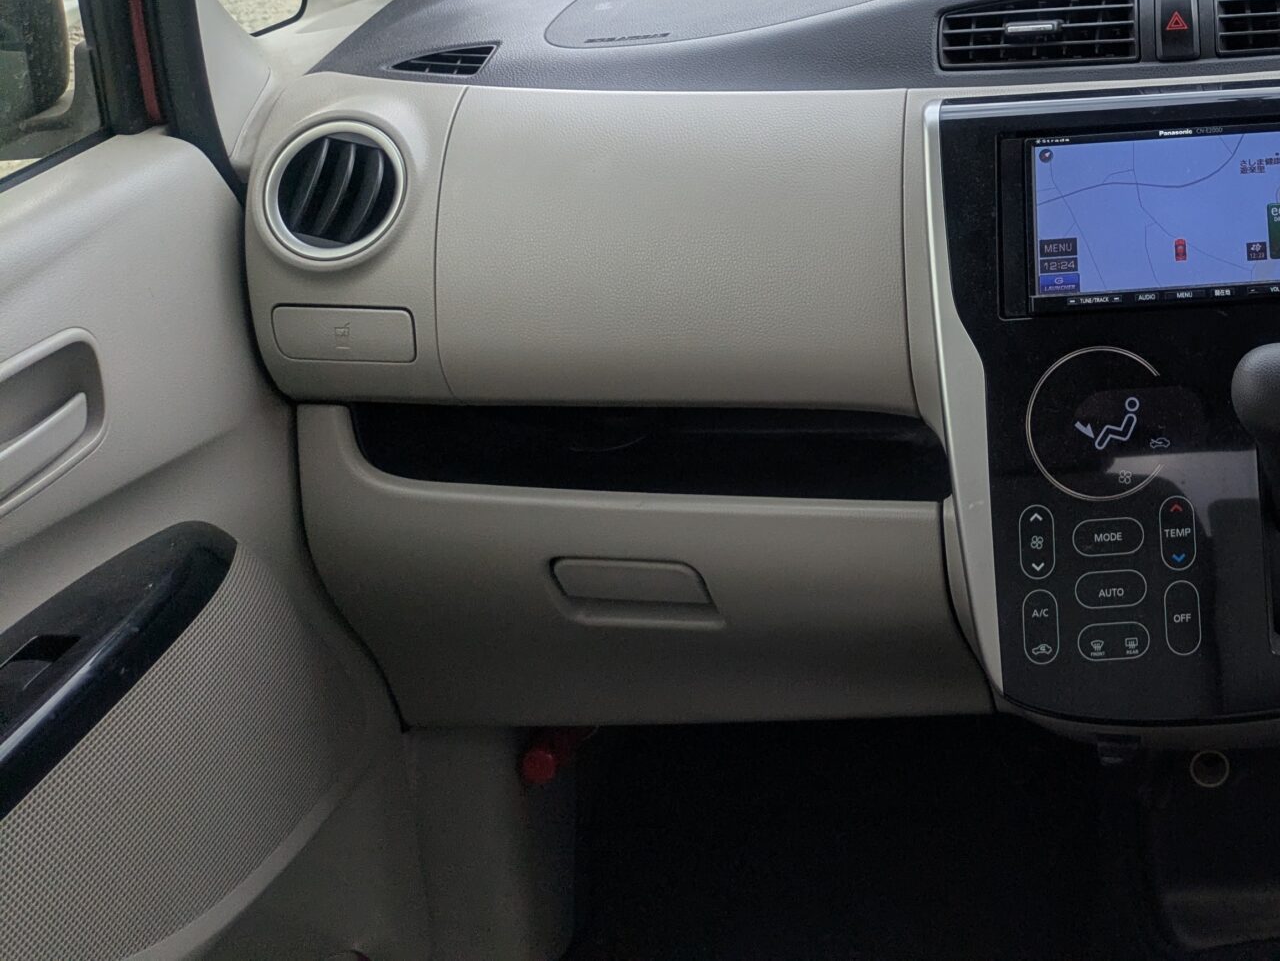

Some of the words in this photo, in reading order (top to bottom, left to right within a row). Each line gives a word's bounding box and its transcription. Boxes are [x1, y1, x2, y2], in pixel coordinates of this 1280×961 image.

[1158, 129, 1193, 137] Panasonic
[1044, 243, 1073, 254] MENU
[1044, 260, 1075, 271] 12:24
[1080, 296, 1110, 304] TUNE/TRACK
[1138, 293, 1156, 301] AUDIO
[1176, 291, 1193, 299] MENU
[1094, 532, 1123, 543] MODE
[1164, 527, 1191, 538] TEMP
[1098, 587, 1125, 598] AUTO
[1031, 608, 1049, 618] A/C
[1173, 613, 1192, 623] OFF
